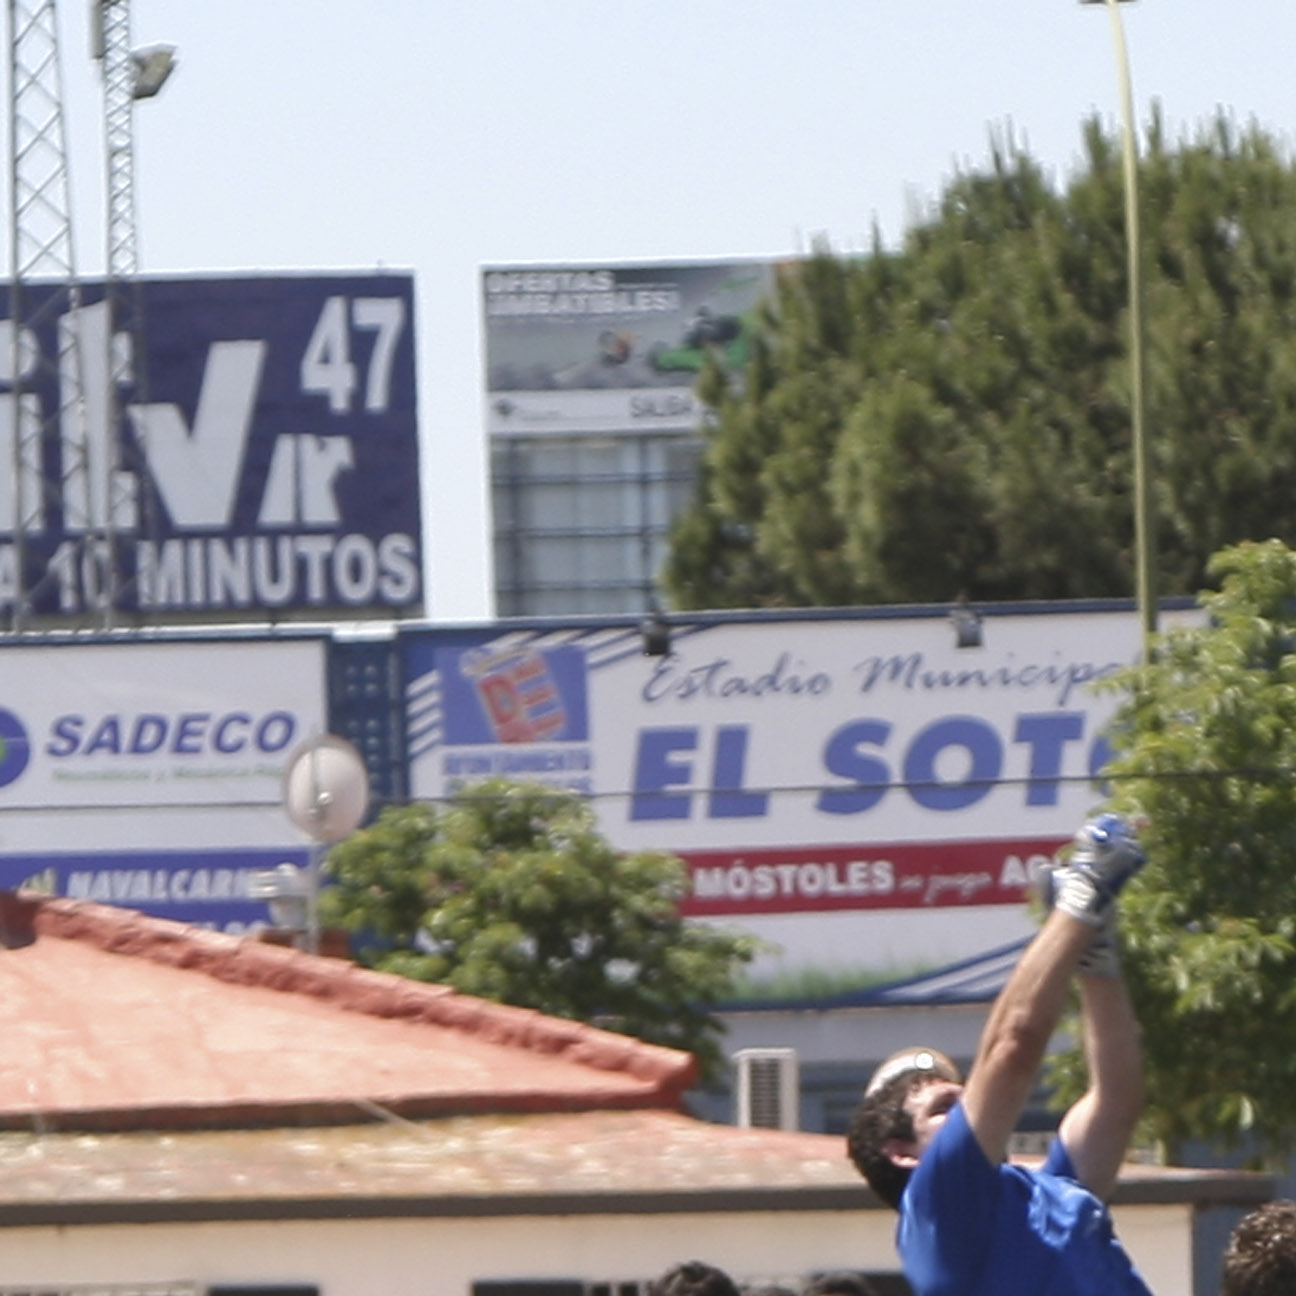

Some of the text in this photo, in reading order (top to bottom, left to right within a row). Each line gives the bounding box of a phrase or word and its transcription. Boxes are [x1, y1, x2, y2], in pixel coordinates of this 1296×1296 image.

[301, 295, 405, 413] 47
[48, 540, 112, 610] 10
[136, 532, 416, 608] MINUTOS
[642, 651, 832, 703] Estadio
[46, 710, 297, 757] SADECO
[628, 712, 1112, 822] EL SOT
[693, 859, 895, 897] MÓSTOLES
